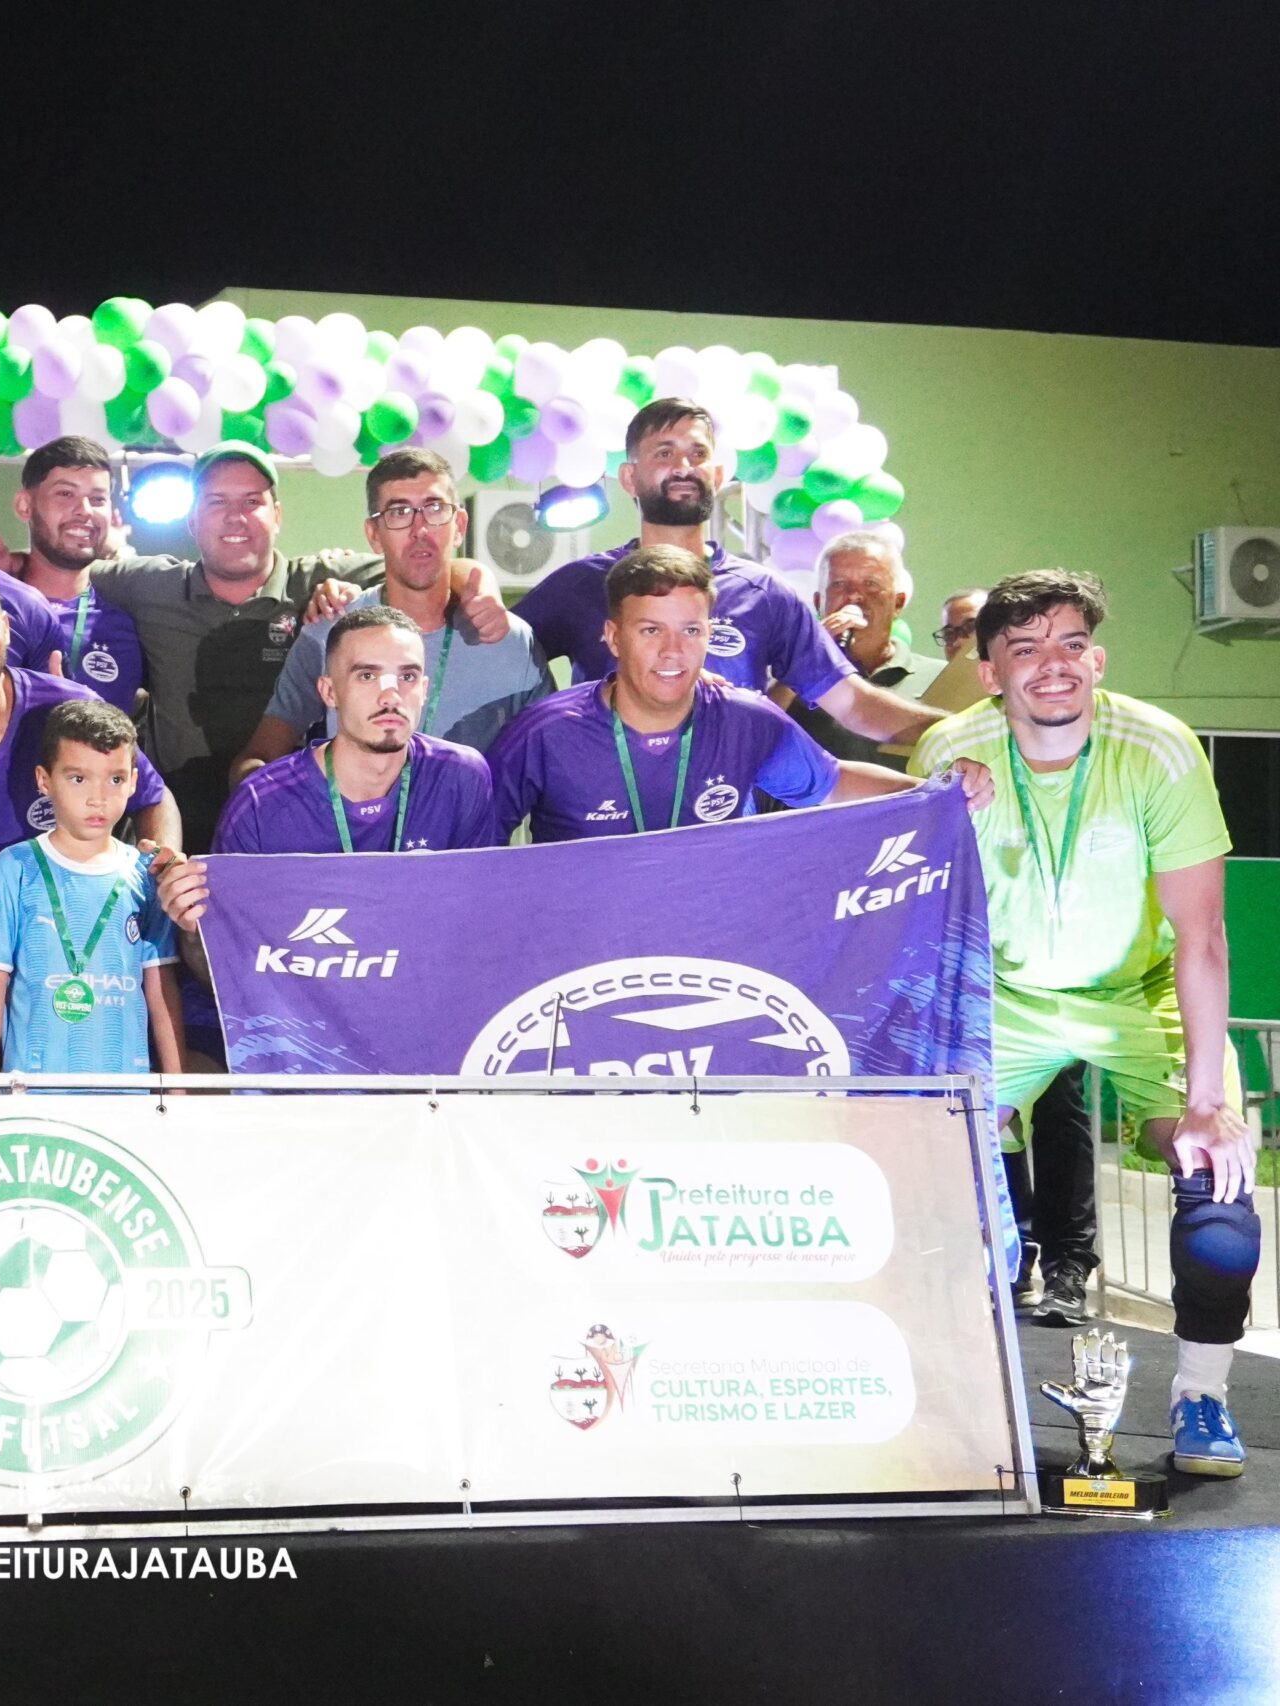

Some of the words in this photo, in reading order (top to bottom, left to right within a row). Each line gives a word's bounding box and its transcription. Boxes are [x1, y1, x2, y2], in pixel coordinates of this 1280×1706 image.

[648, 736, 670, 747] PSV
[360, 804, 382, 816] PSV
[585, 810, 629, 821] Kariri
[834, 861, 953, 921] Kariri
[255, 944, 401, 979] Kariri
[45, 973, 137, 993] EIHAD
[638, 1177, 791, 1206] Prefeitura
[799, 1184, 835, 1206] de
[637, 1190, 852, 1251] JATAÚBA
[144, 1278, 230, 1319] 2025
[649, 1358, 746, 1376] Secretaria
[750, 1357, 842, 1378] Municipal
[847, 1357, 872, 1374] de
[649, 1379, 765, 1400] CULTURA,
[769, 1376, 894, 1398] ESPORTES,
[651, 1402, 758, 1423] TURISMO
[764, 1402, 778, 1421] E
[783, 1401, 858, 1421] LAZER
